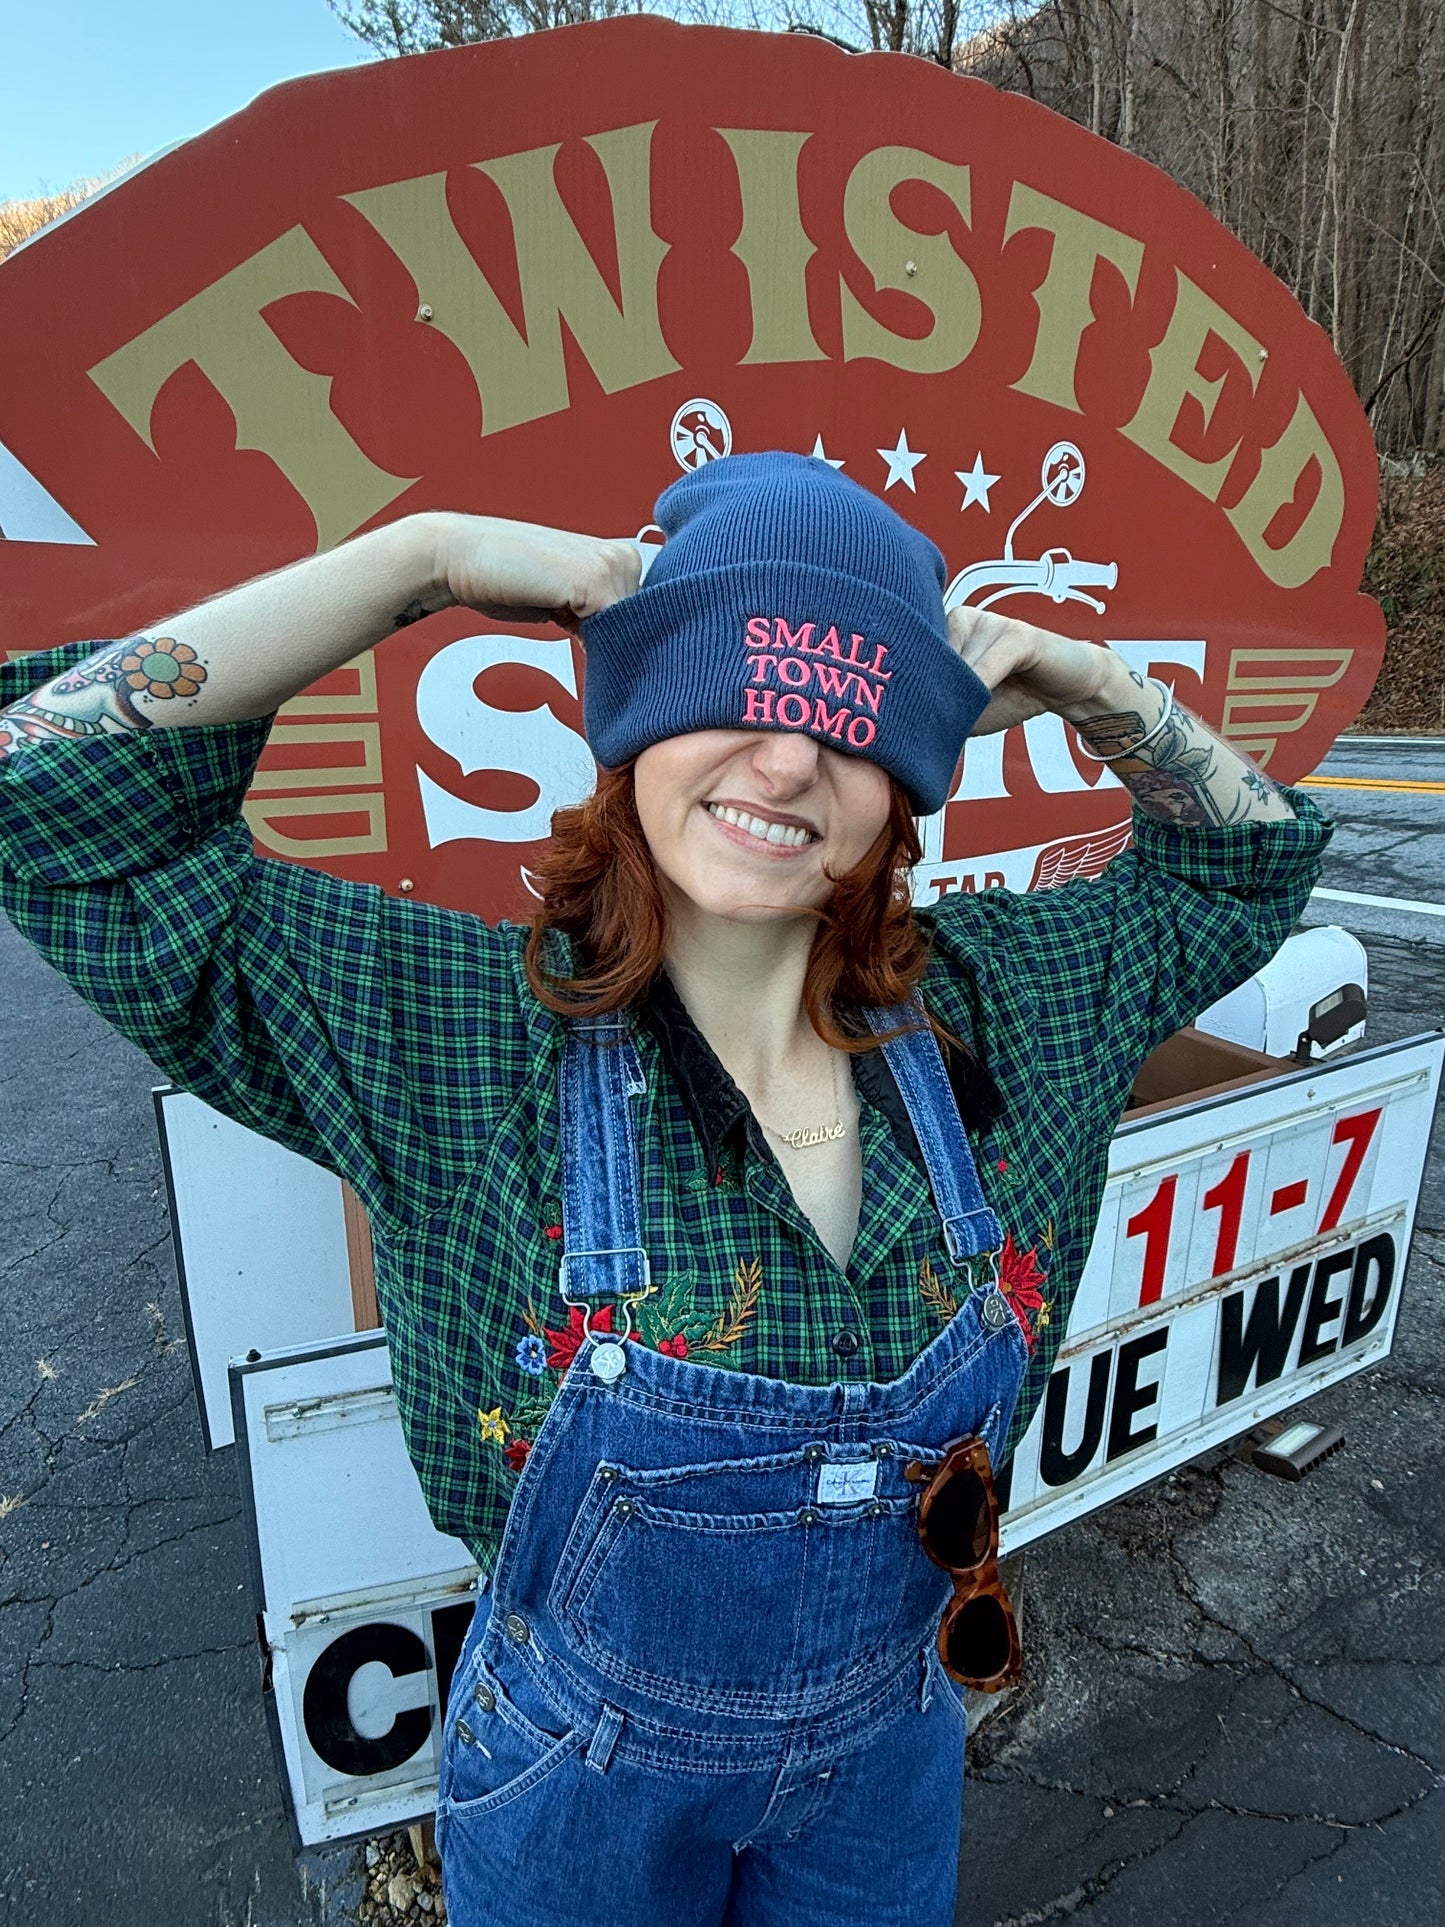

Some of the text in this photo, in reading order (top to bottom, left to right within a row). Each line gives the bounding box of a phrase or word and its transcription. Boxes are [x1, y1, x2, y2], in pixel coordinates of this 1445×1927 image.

[87, 118, 1345, 589] TWISTED
[745, 617, 893, 680] SMALL
[747, 654, 885, 716] TOWN
[742, 688, 877, 748] HOMO
[1126, 1107, 1383, 1308] 11-7
[999, 1232, 1396, 1515] UE WED
